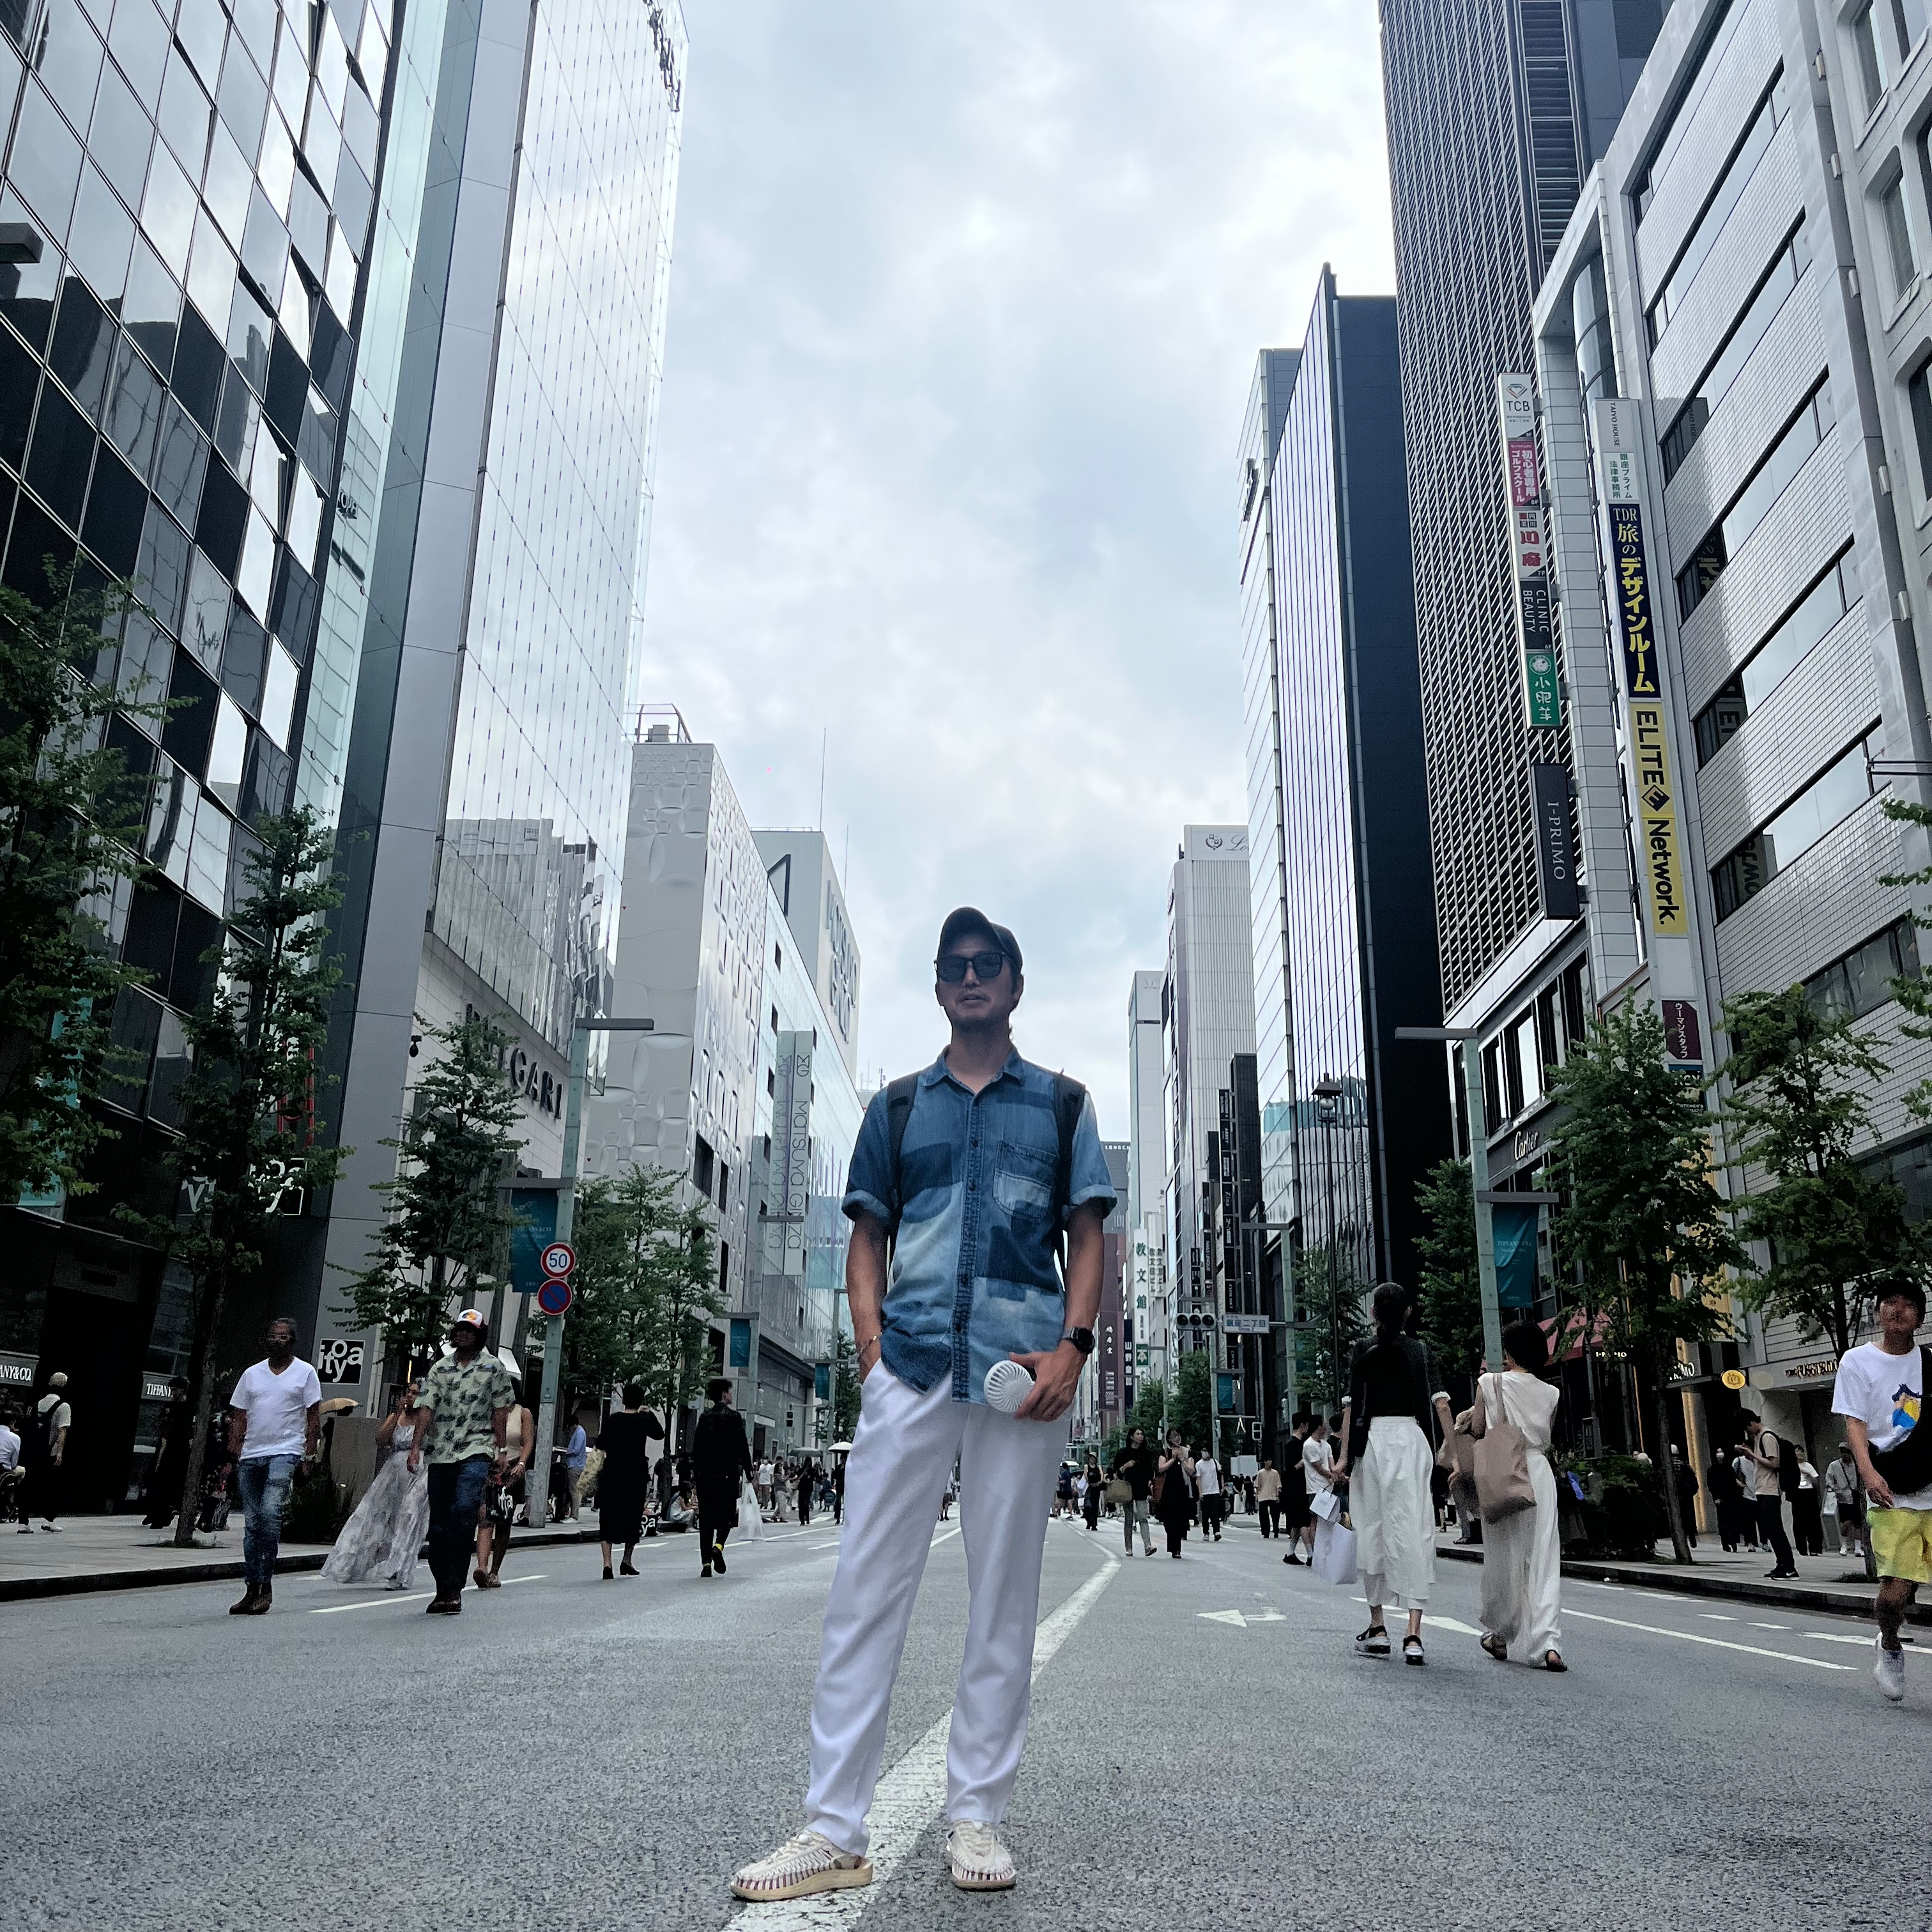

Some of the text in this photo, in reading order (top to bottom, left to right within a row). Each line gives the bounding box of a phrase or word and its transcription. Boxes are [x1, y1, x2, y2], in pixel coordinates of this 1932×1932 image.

[1506, 401, 1530, 411] TCB
[1612, 424, 1620, 447] HOUSE
[1512, 450, 1525, 503] ゴルフスクール
[1609, 460, 1621, 499] 法律事務所
[1613, 508, 1637, 521] TDR
[1522, 590, 1536, 632] BEAUTY
[1536, 590, 1549, 632] CLINIC
[1617, 523, 1655, 693] 旅のデザインルーム
[1636, 710, 1665, 786] ELITE
[1547, 801, 1566, 880] I-PRIMO
[1514, 1131, 1538, 1160] Cartier
[549, 1253, 567, 1268] 50
[1136, 1242, 1147, 1309] 教文館
[1227, 1319, 1266, 1328] 銀座二丁目
